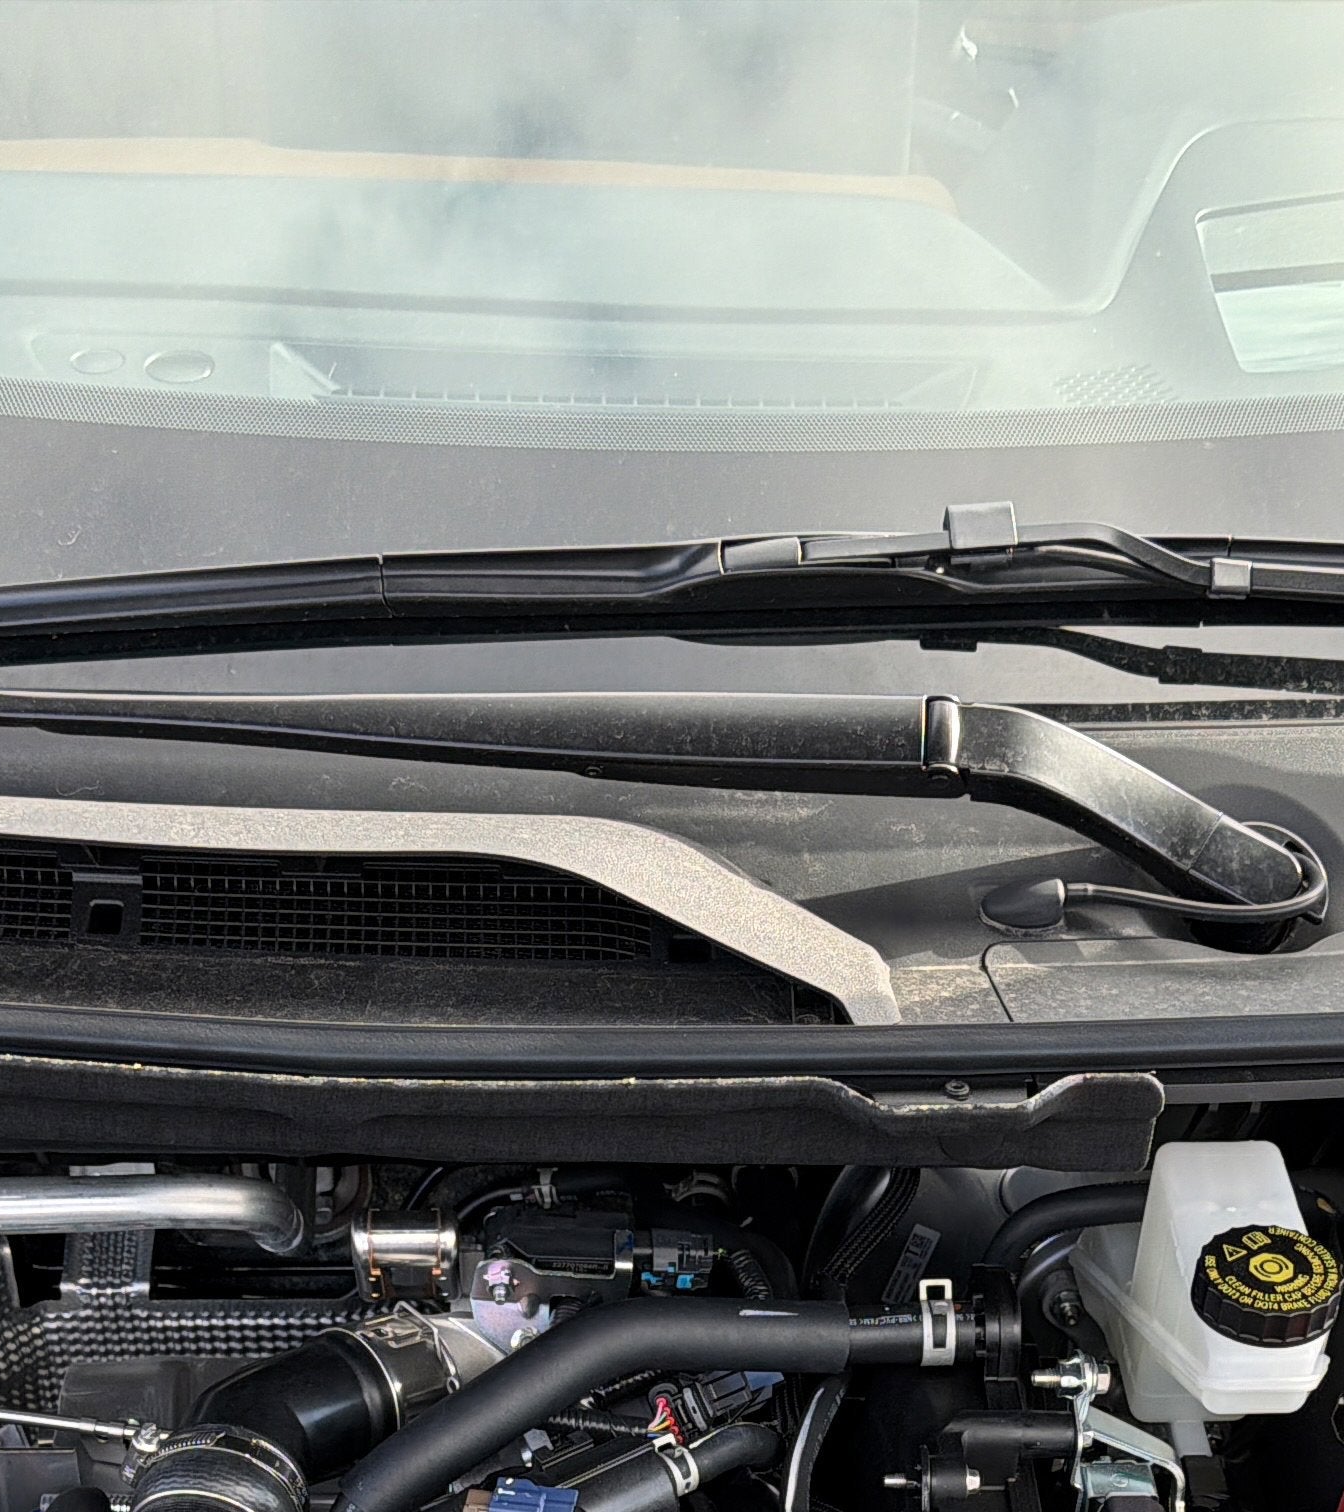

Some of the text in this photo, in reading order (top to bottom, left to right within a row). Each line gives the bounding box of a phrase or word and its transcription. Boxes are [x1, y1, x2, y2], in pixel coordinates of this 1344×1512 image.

[1225, 1275, 1252, 1295] CLEAN
[1251, 1289, 1284, 1302] FILLER
[1284, 1291, 1302, 1300] CAP
[1238, 1295, 1254, 1305] OR
[1254, 1300, 1279, 1311] DOT4
[1280, 1300, 1312, 1312] BRAKE
